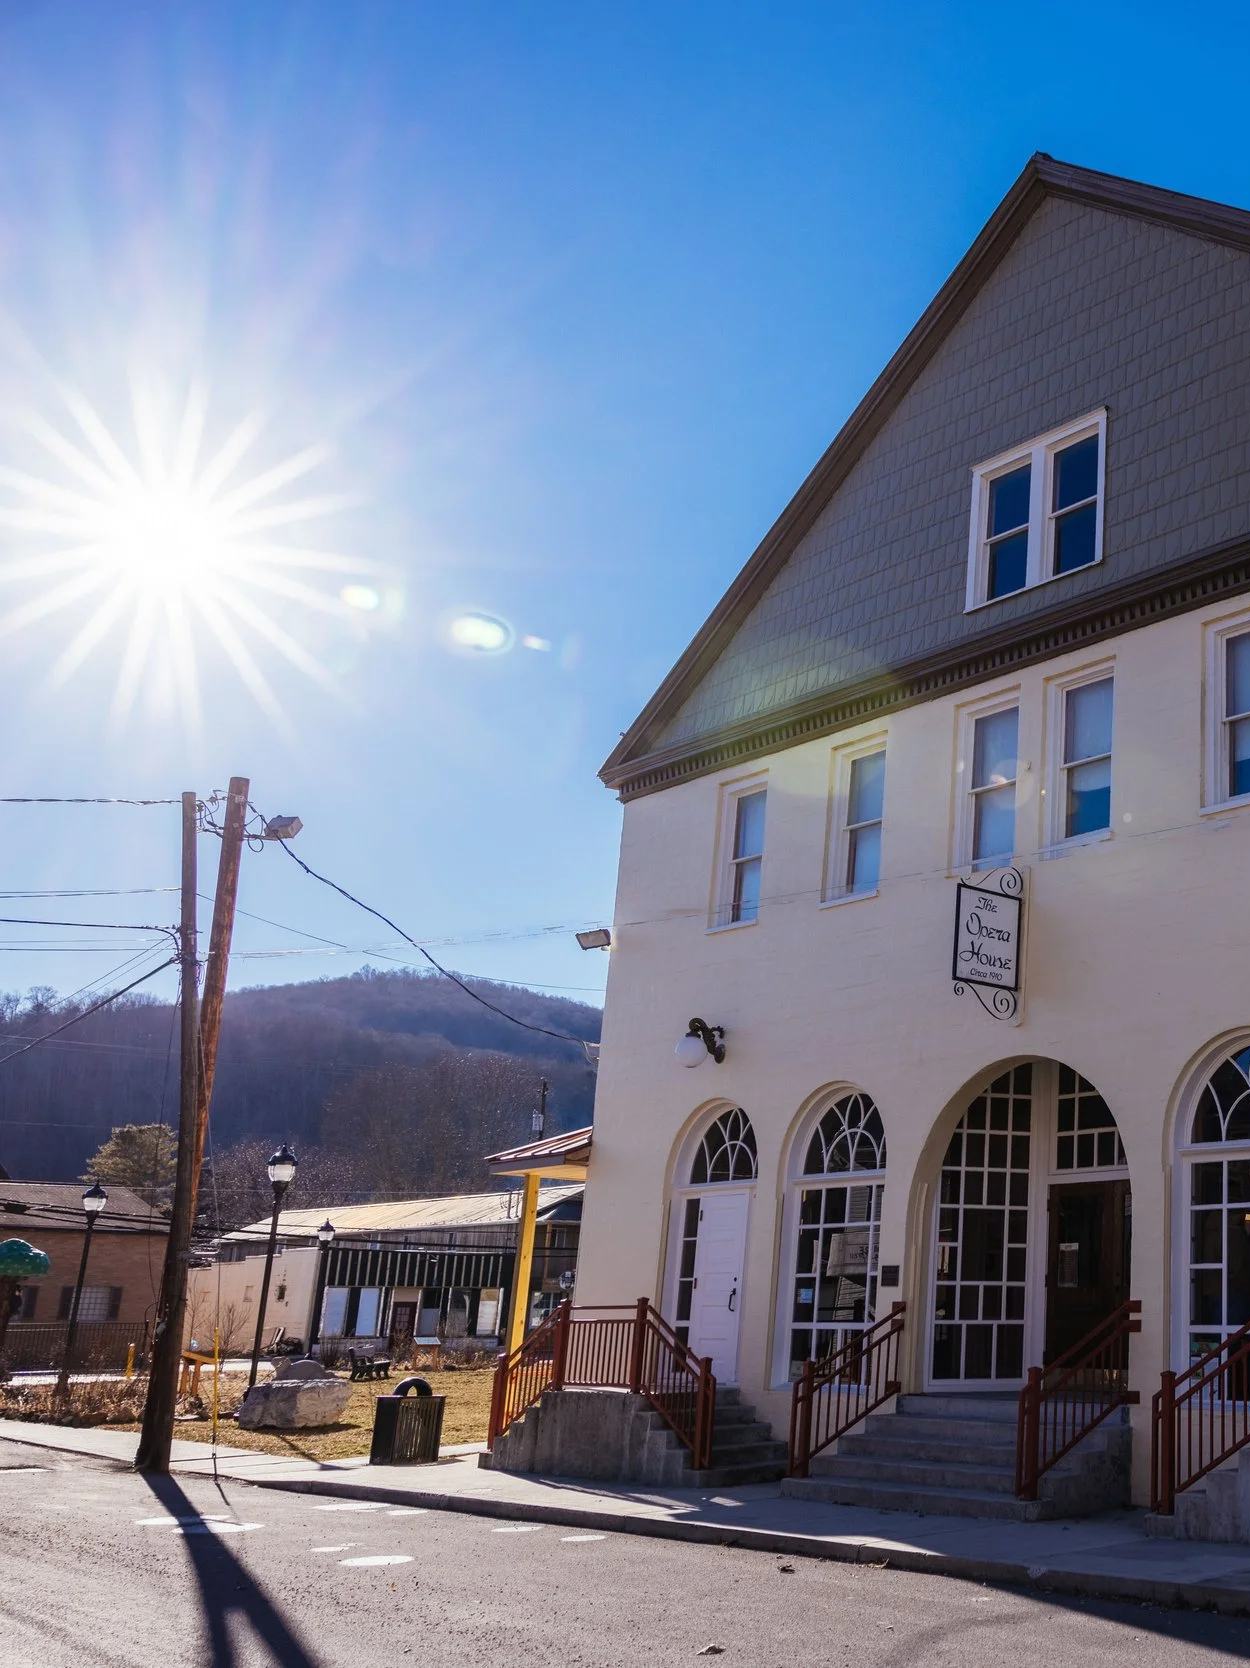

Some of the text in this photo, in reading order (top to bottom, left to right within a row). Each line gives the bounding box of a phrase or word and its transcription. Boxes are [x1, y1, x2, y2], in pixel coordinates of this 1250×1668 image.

[975, 897, 998, 913] The
[966, 912, 1011, 942] Opera
[959, 940, 1012, 970] House
[970, 968, 1003, 982] Circa 1910
